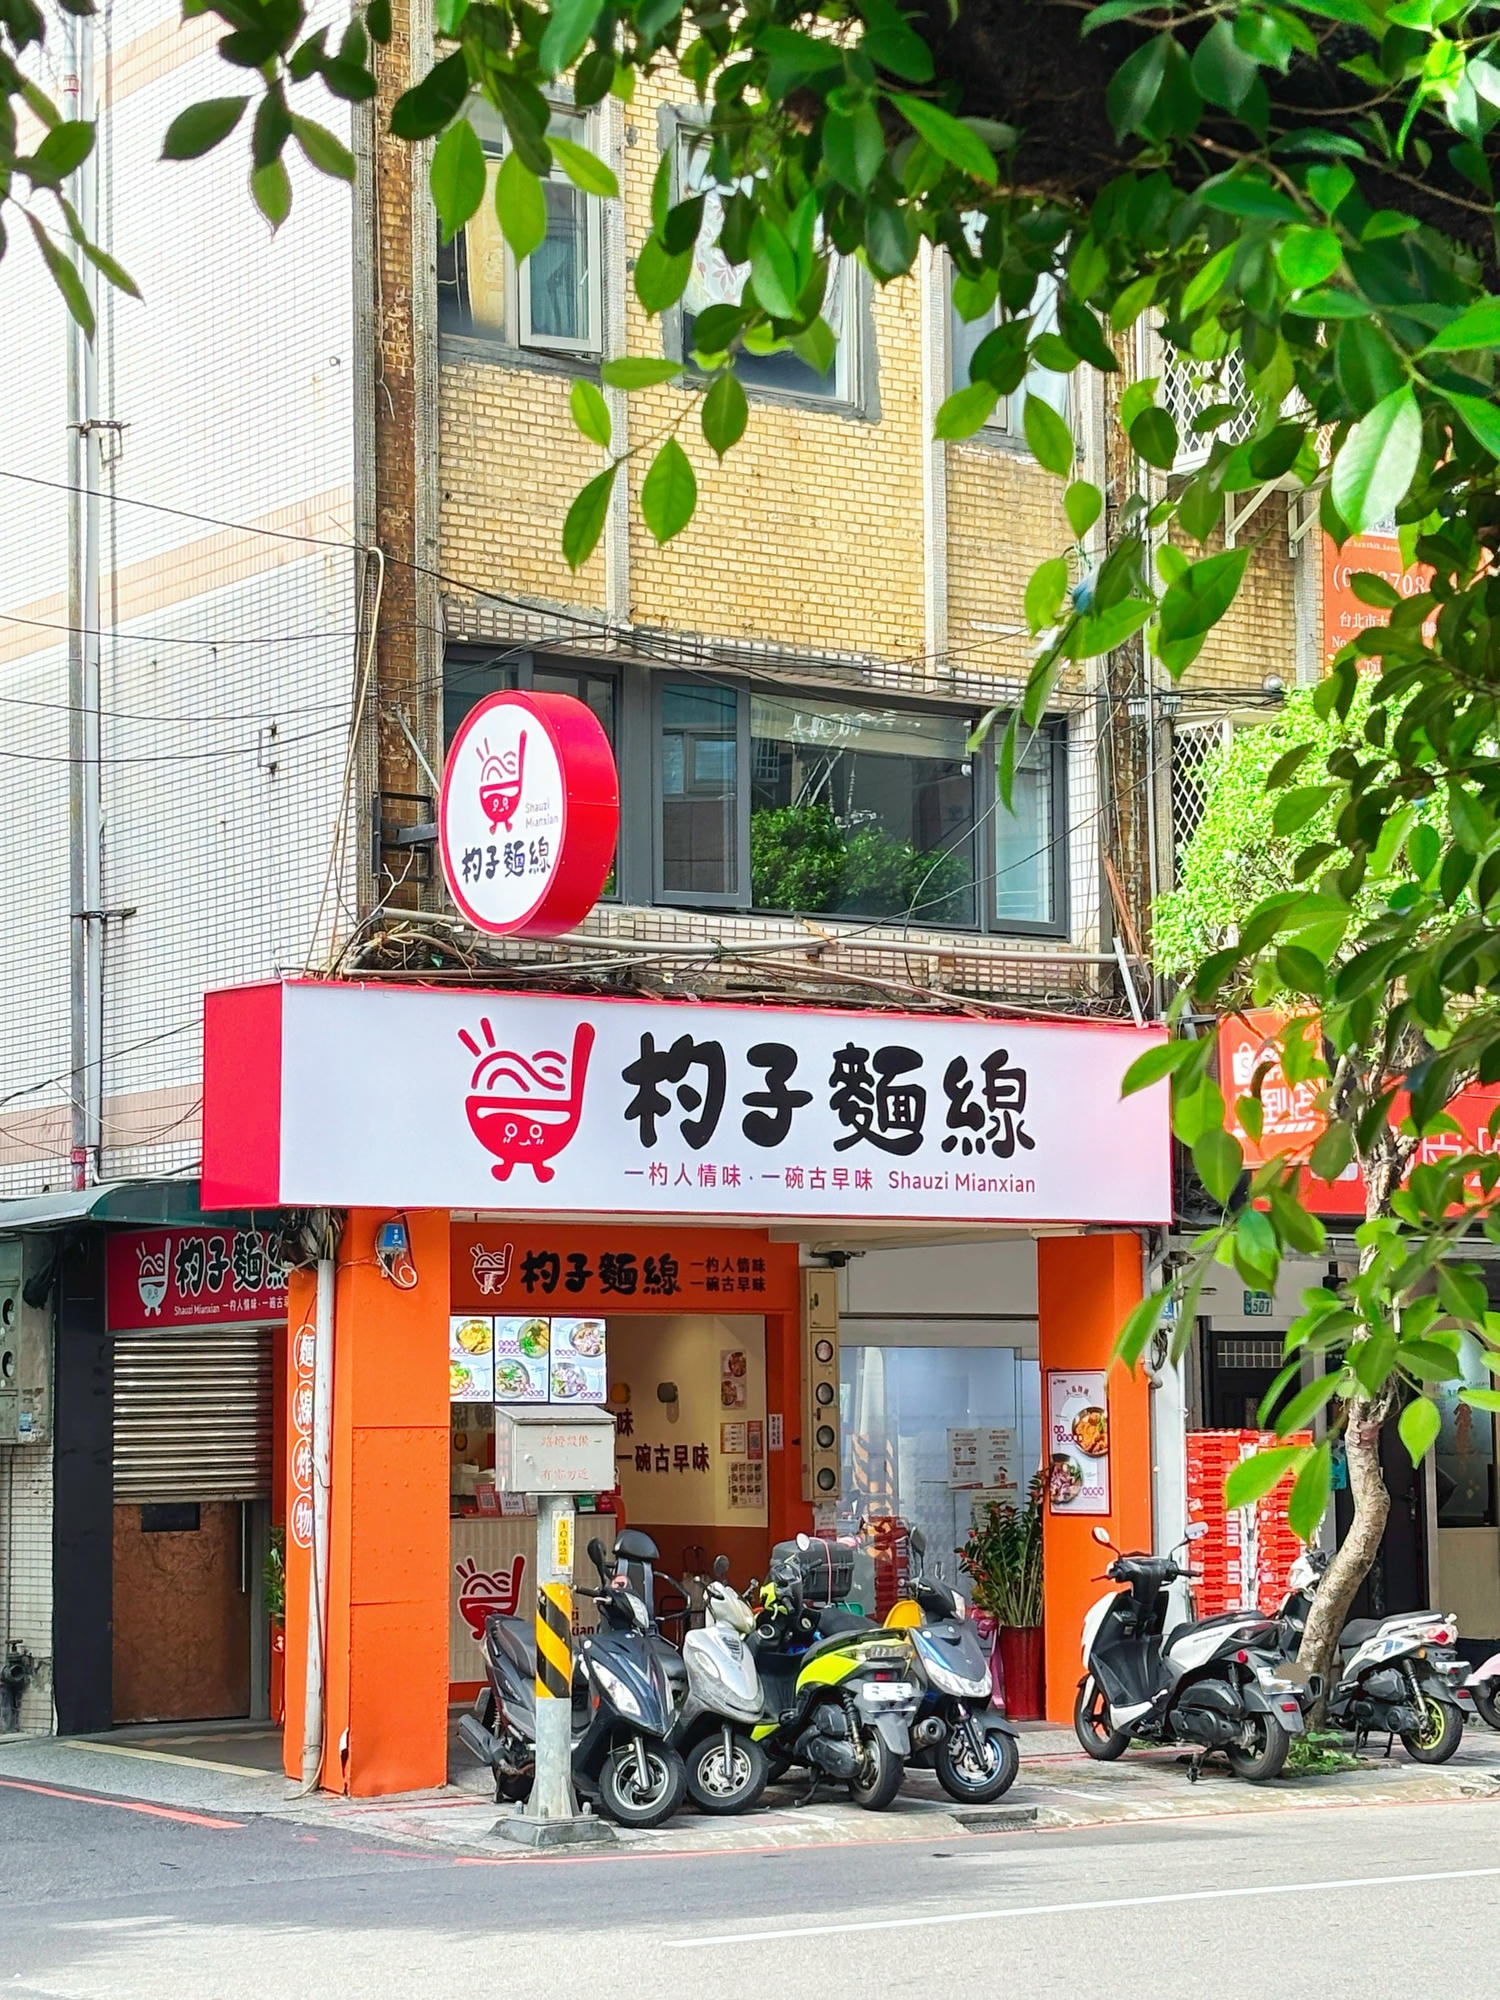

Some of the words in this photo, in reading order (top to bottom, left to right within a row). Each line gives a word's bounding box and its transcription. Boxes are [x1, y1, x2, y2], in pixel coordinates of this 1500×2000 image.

[525, 797, 550, 814] Shauzi
[462, 836, 551, 884] 杓子麵線
[621, 1032, 1036, 1159] 杓子麵線
[888, 1170, 949, 1190] Shauzi
[955, 1173, 1035, 1193] Mianxian
[520, 1250, 682, 1296] 杓子麵線
[616, 1443, 710, 1473] 一碗古早味
